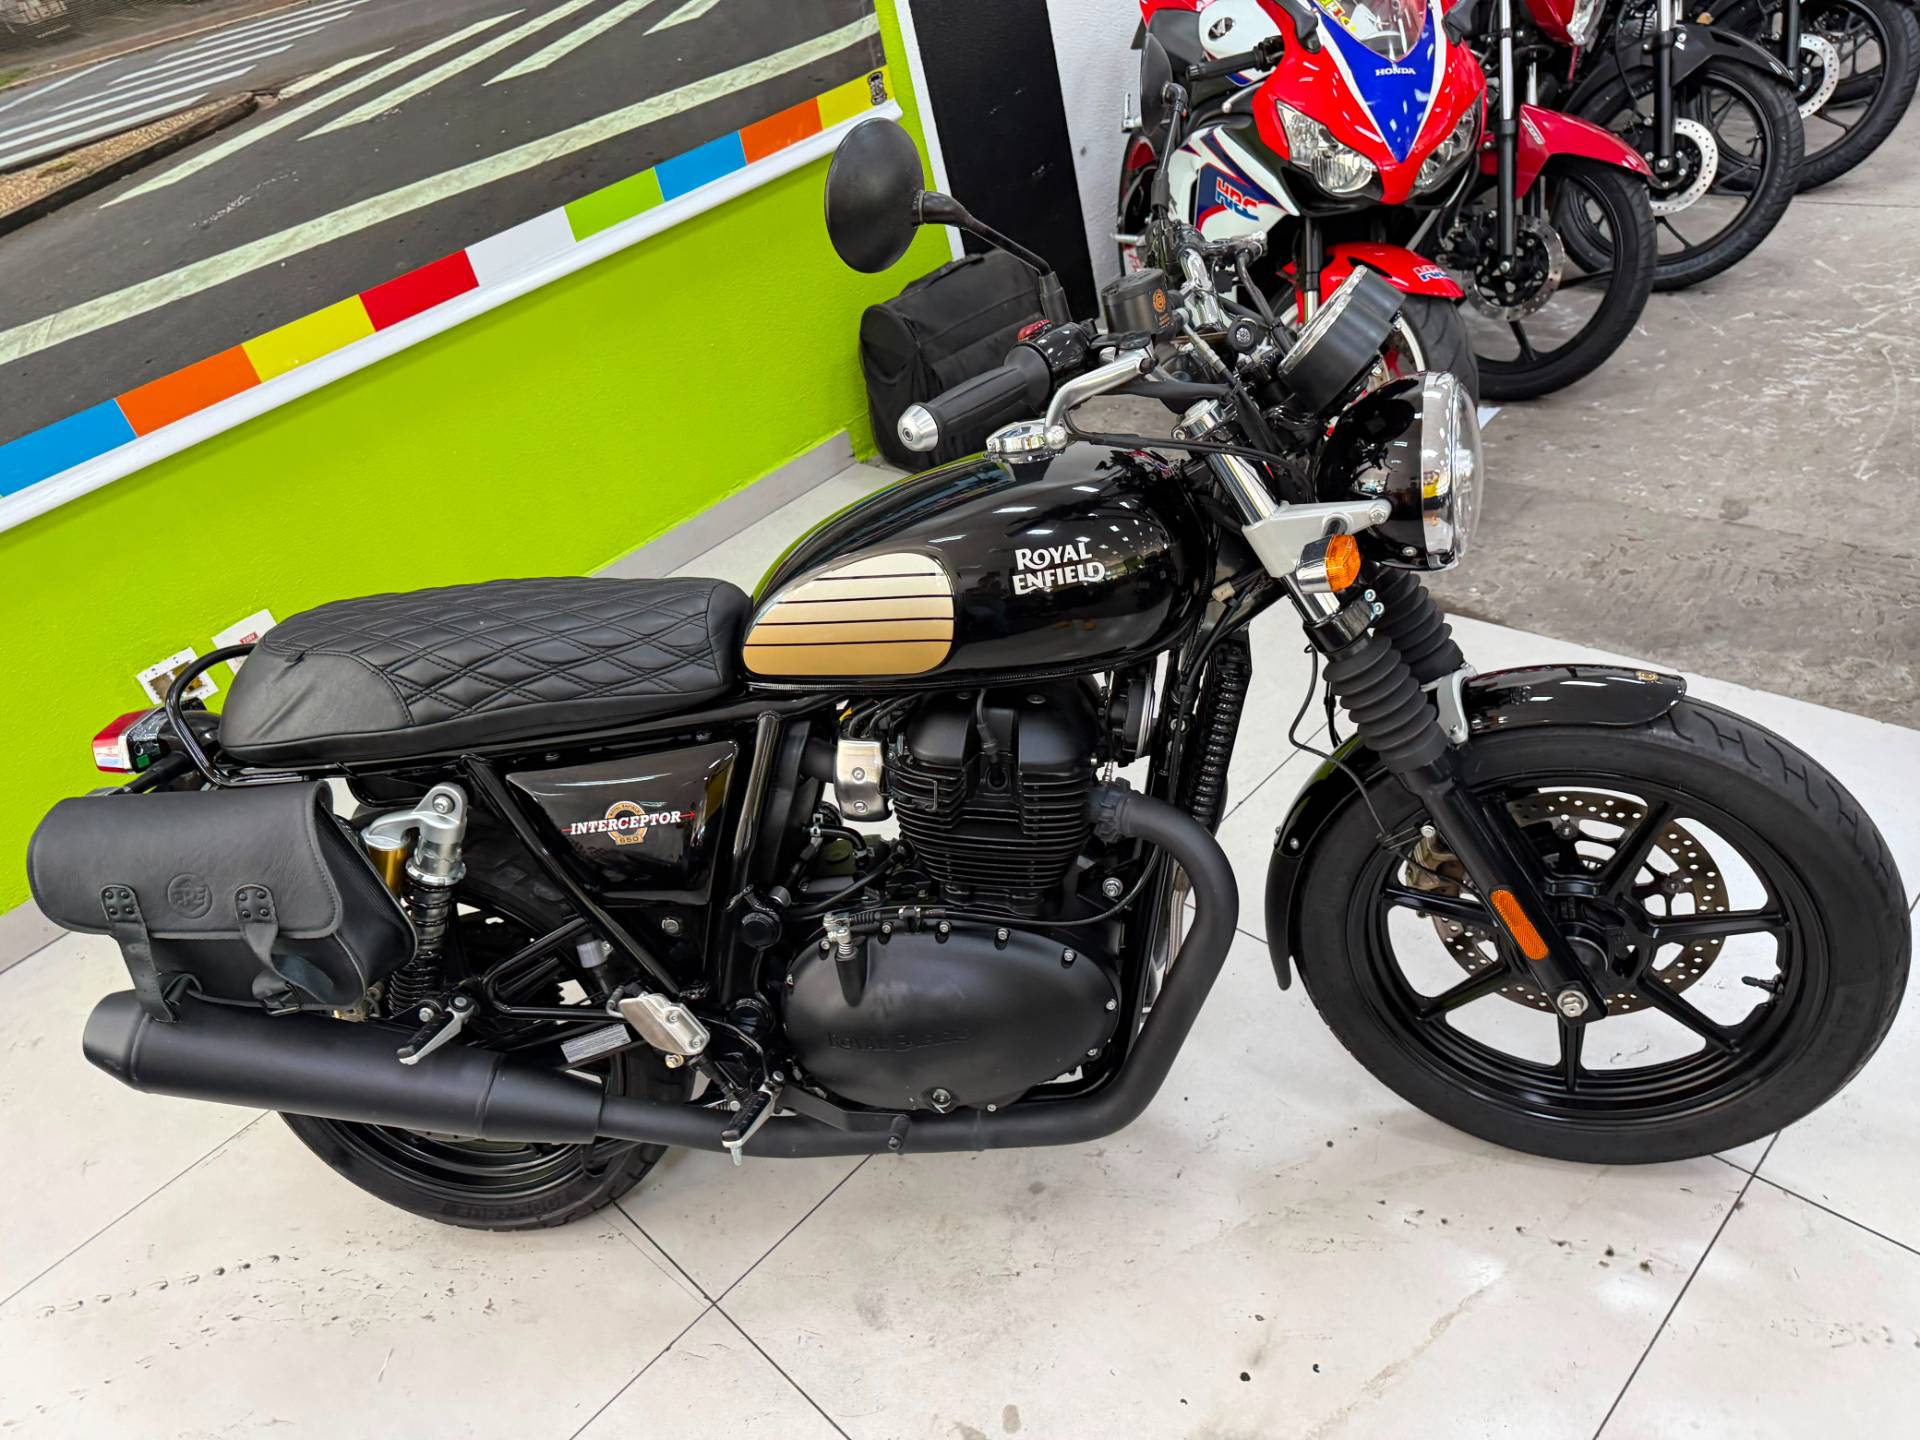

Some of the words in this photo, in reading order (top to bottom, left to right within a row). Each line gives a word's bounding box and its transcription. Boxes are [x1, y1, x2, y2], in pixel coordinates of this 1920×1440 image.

[1375, 67, 1416, 76] HONDA
[1216, 176, 1260, 221] HRC
[1015, 542, 1093, 571] ROYAL
[1012, 561, 1106, 596] ENFIELD
[570, 810, 681, 835] INTERCEPTOR
[619, 836, 640, 844] 650
